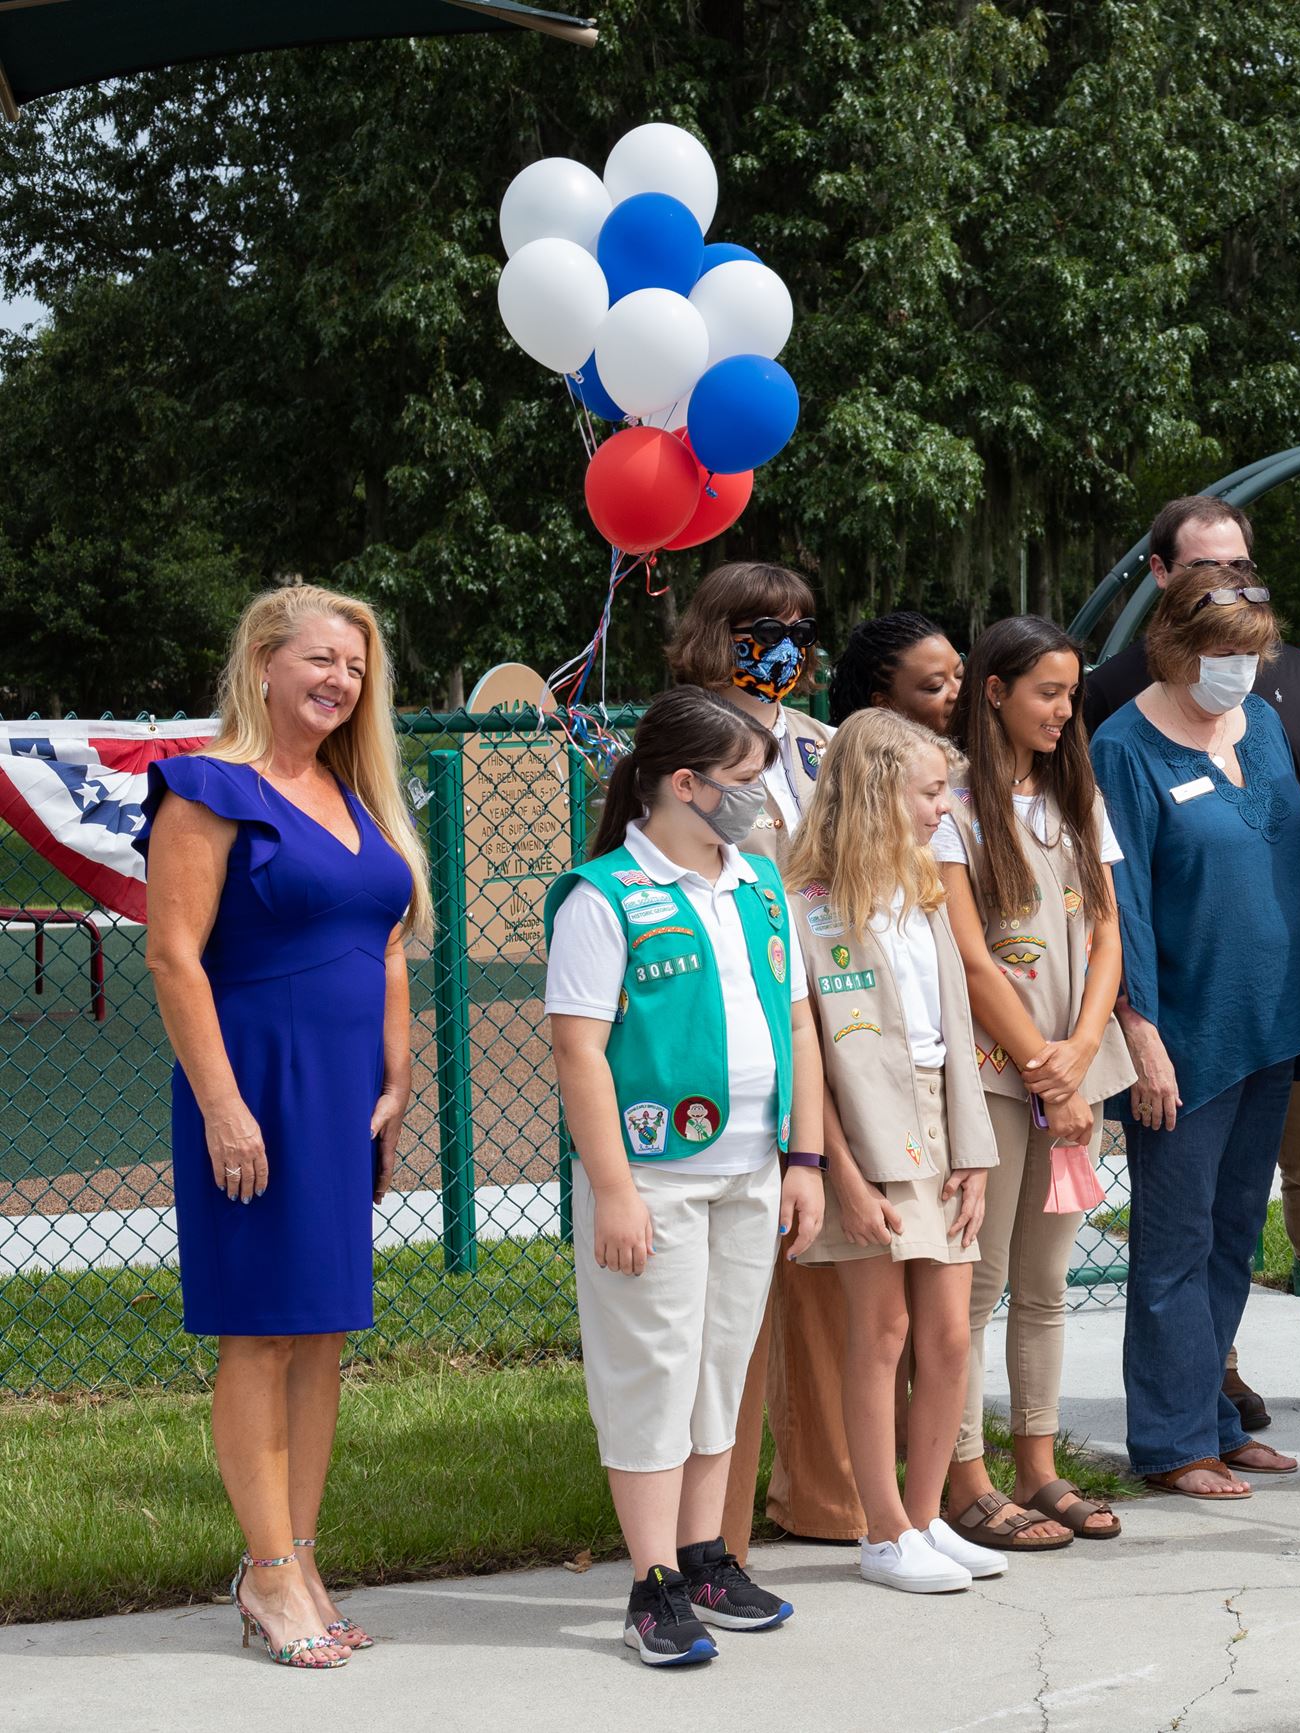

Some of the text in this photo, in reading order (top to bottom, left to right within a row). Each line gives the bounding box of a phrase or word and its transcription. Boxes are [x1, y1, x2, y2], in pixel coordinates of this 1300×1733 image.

[487, 755, 503, 767] THIS
[518, 806, 528, 817] OF
[482, 821, 556, 837] ADUT SUPEVISION
[485, 843, 493, 855] IS
[515, 859, 522, 874] IT
[636, 954, 699, 982] 30411
[822, 972, 873, 991] 30411
